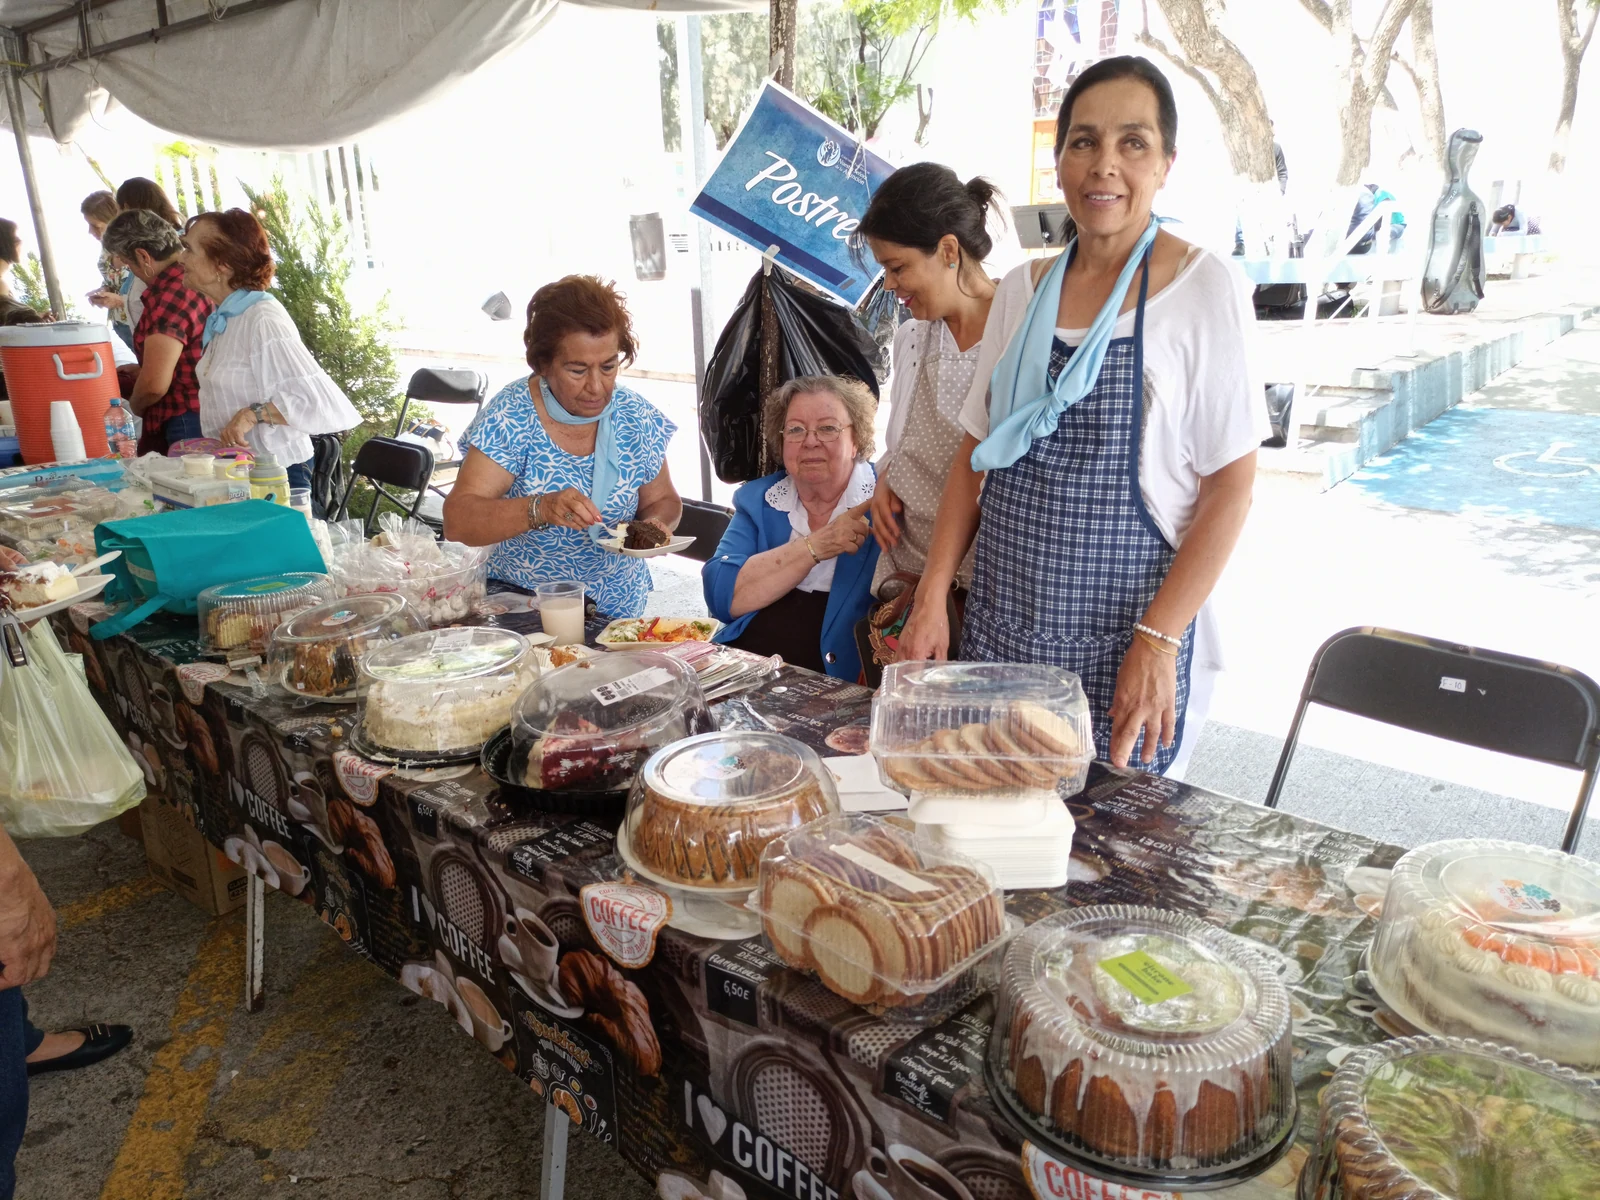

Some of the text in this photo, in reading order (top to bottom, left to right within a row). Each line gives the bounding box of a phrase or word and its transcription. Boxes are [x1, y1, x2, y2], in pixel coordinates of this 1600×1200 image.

[245, 789, 293, 840] COFFEE
[412, 885, 495, 986] I COFFEE
[590, 896, 658, 933] COFFEE
[684, 1079, 693, 1128] I
